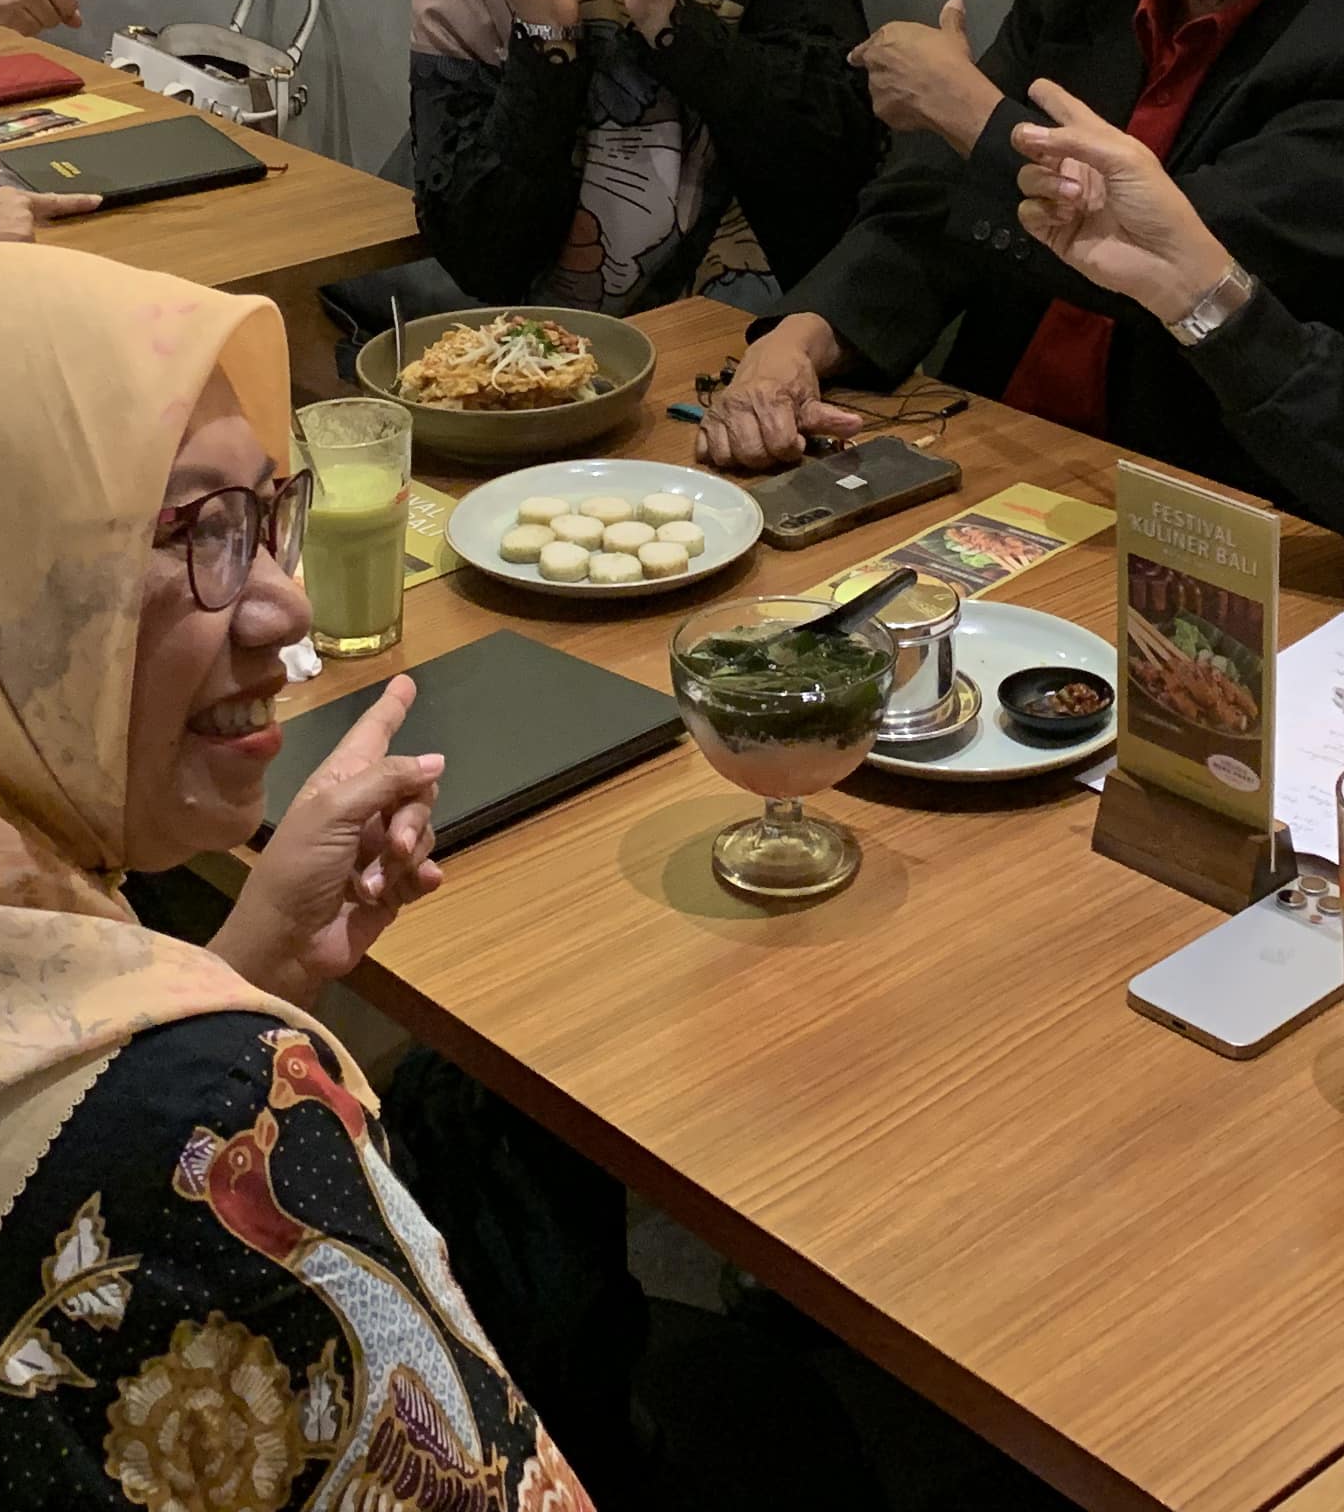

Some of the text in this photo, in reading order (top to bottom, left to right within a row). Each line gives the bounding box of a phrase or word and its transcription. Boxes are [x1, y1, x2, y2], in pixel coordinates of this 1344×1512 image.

[1128, 512, 1209, 559] KULINER
[1216, 546, 1257, 576] BALI
[1151, 500, 1237, 547] FESTIVAL
